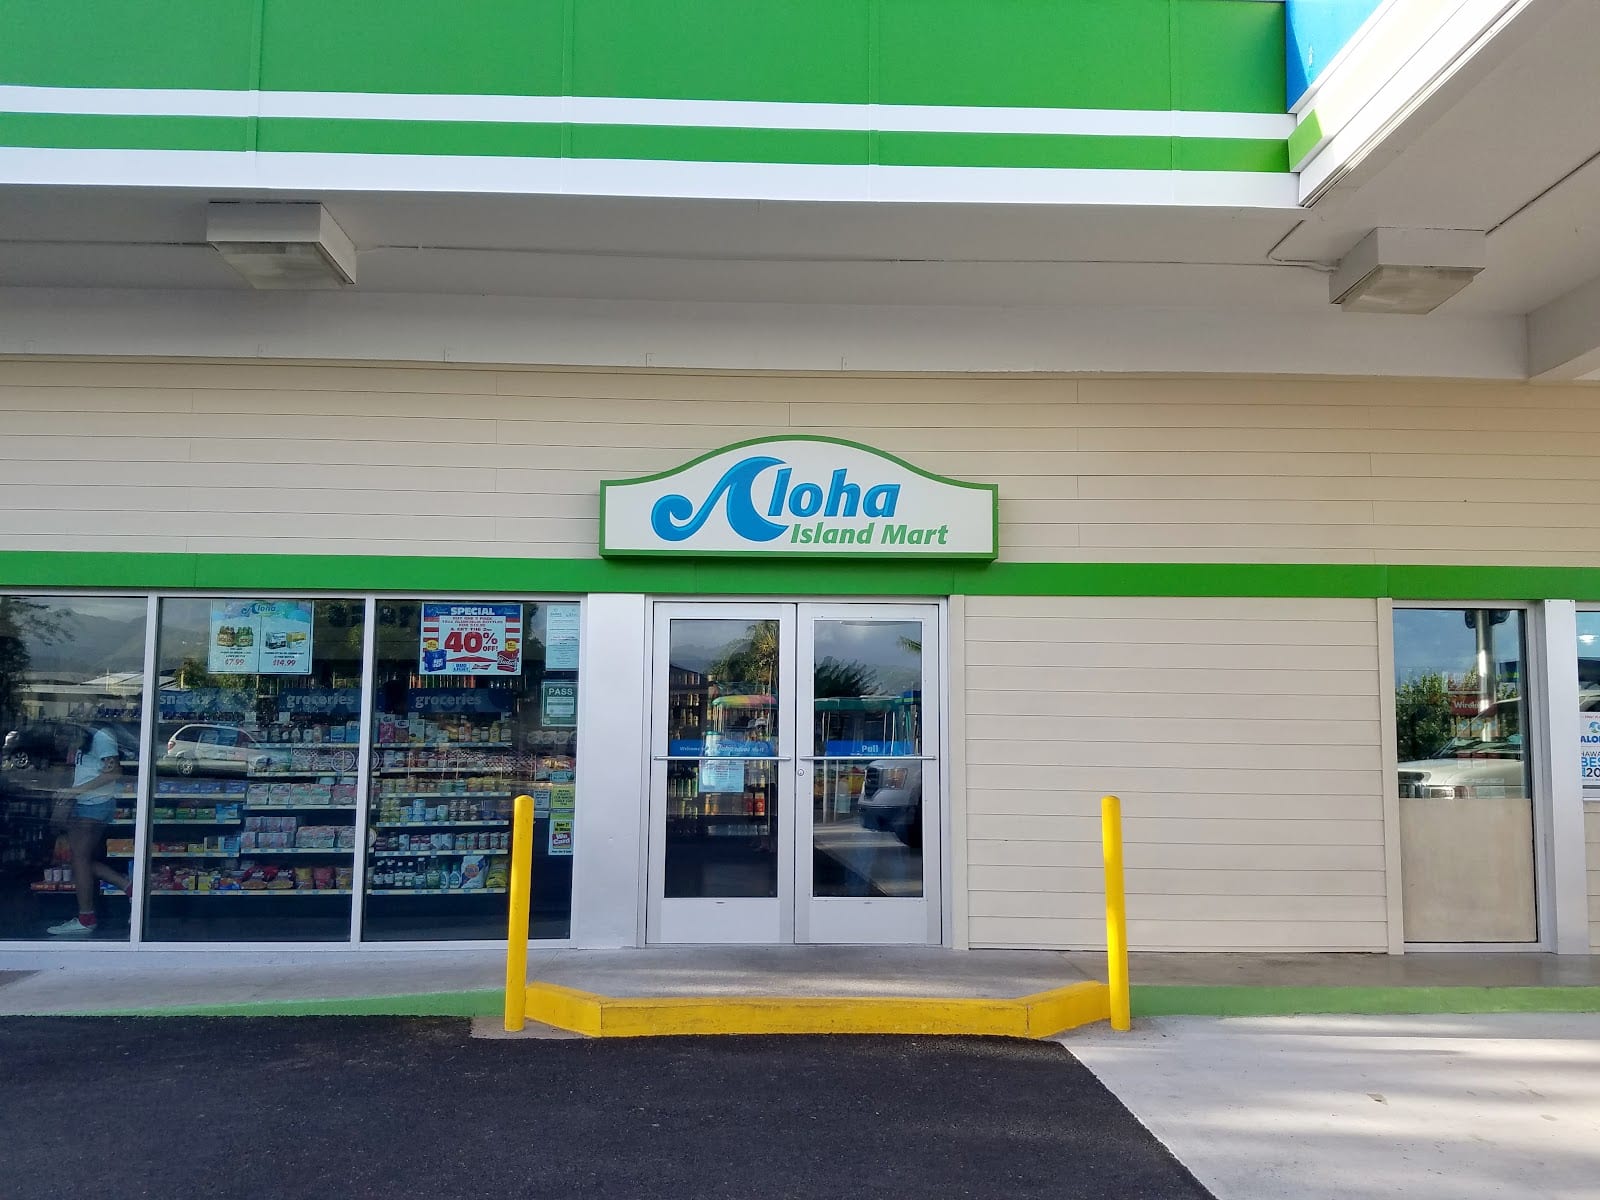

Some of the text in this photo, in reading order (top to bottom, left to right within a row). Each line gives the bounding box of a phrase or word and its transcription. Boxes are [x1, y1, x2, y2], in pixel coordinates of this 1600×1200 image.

[651, 456, 901, 543] Aloha
[790, 521, 948, 545] Island Mart
[450, 606, 496, 616] SPECIAL
[548, 687, 573, 696] PASS
[286, 693, 354, 708] groceries
[414, 694, 483, 709] groceries
[861, 744, 879, 753] Pull
